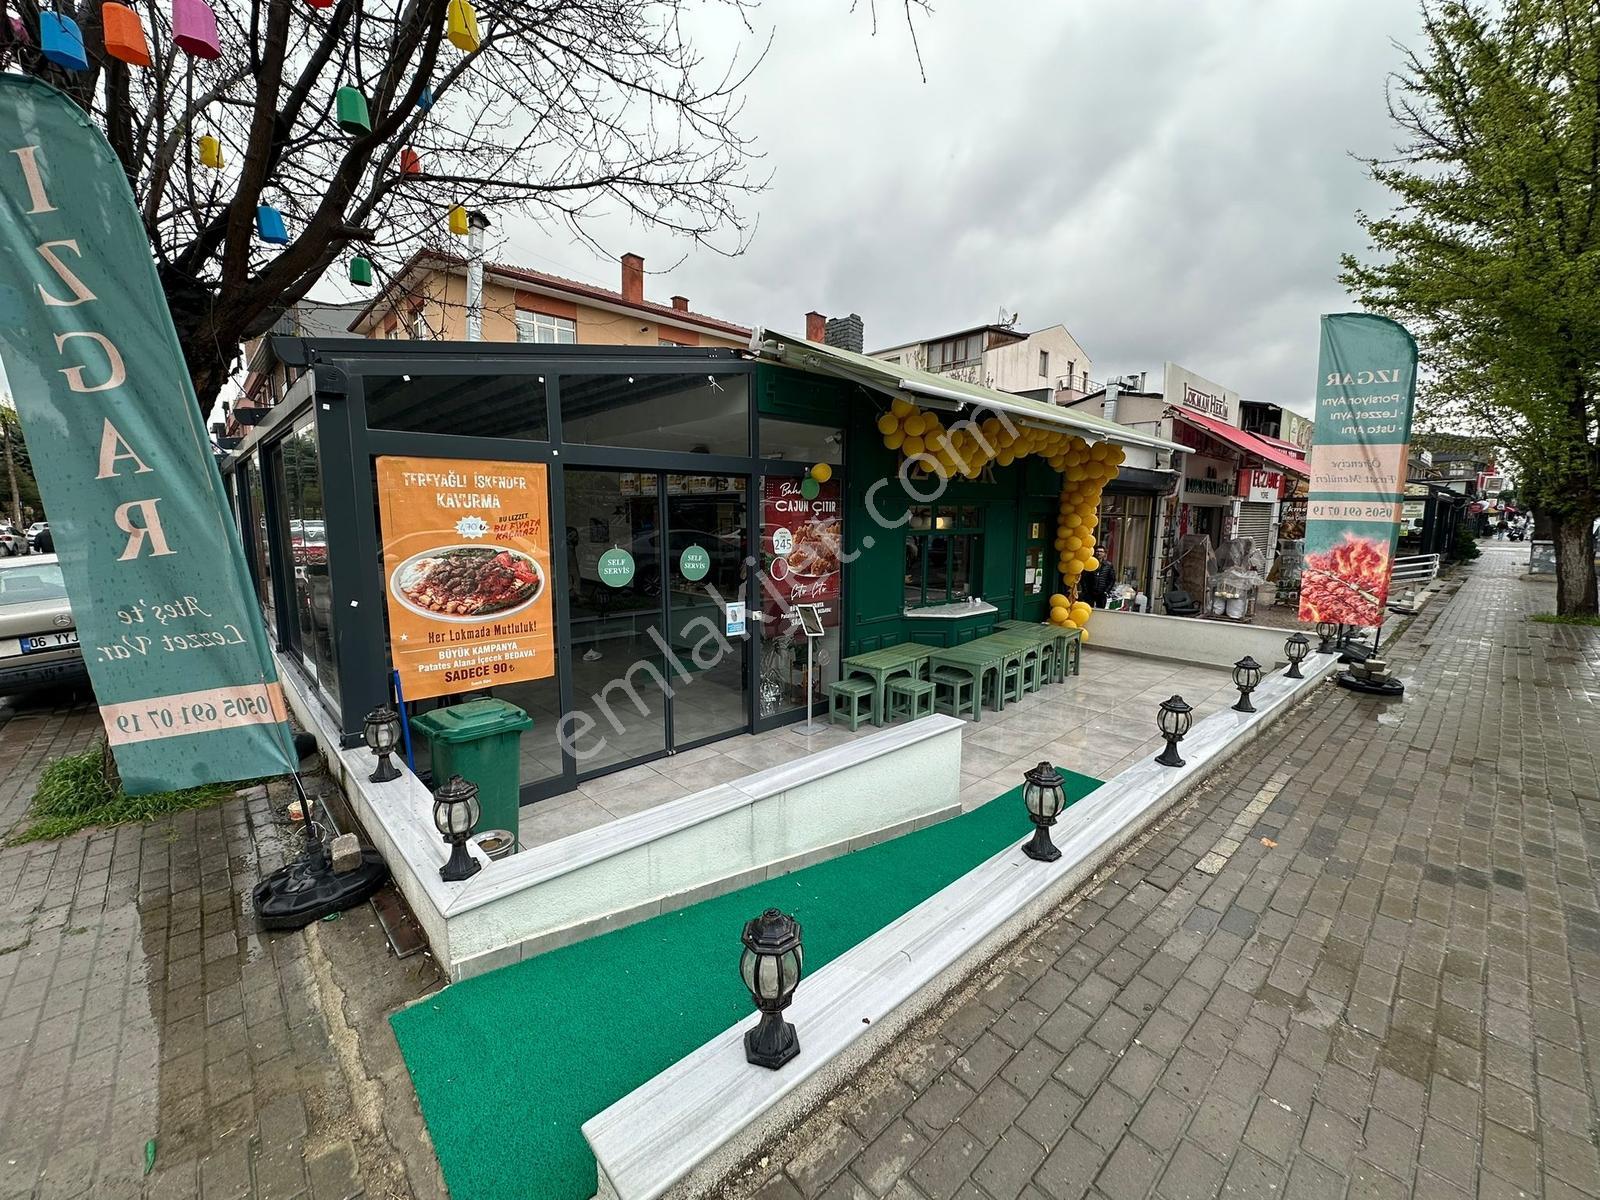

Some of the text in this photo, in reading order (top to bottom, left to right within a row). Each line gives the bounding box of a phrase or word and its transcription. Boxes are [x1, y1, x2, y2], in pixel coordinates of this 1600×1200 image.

[436, 492, 501, 509] KAVURMA
[775, 500, 837, 516] CAJUN ÇITIR
[774, 538, 792, 550] 245
[603, 566, 631, 575] SERVİS
[428, 620, 537, 643] Her Lokmada Mutluluk!
[30, 637, 46, 648] 06
[438, 642, 518, 660] BÜYÜK KAMPANYA
[418, 662, 451, 672] Patates
[453, 659, 476, 668] Alana
[504, 649, 536, 660] BEDAVA!
[445, 665, 490, 683] SADECE
